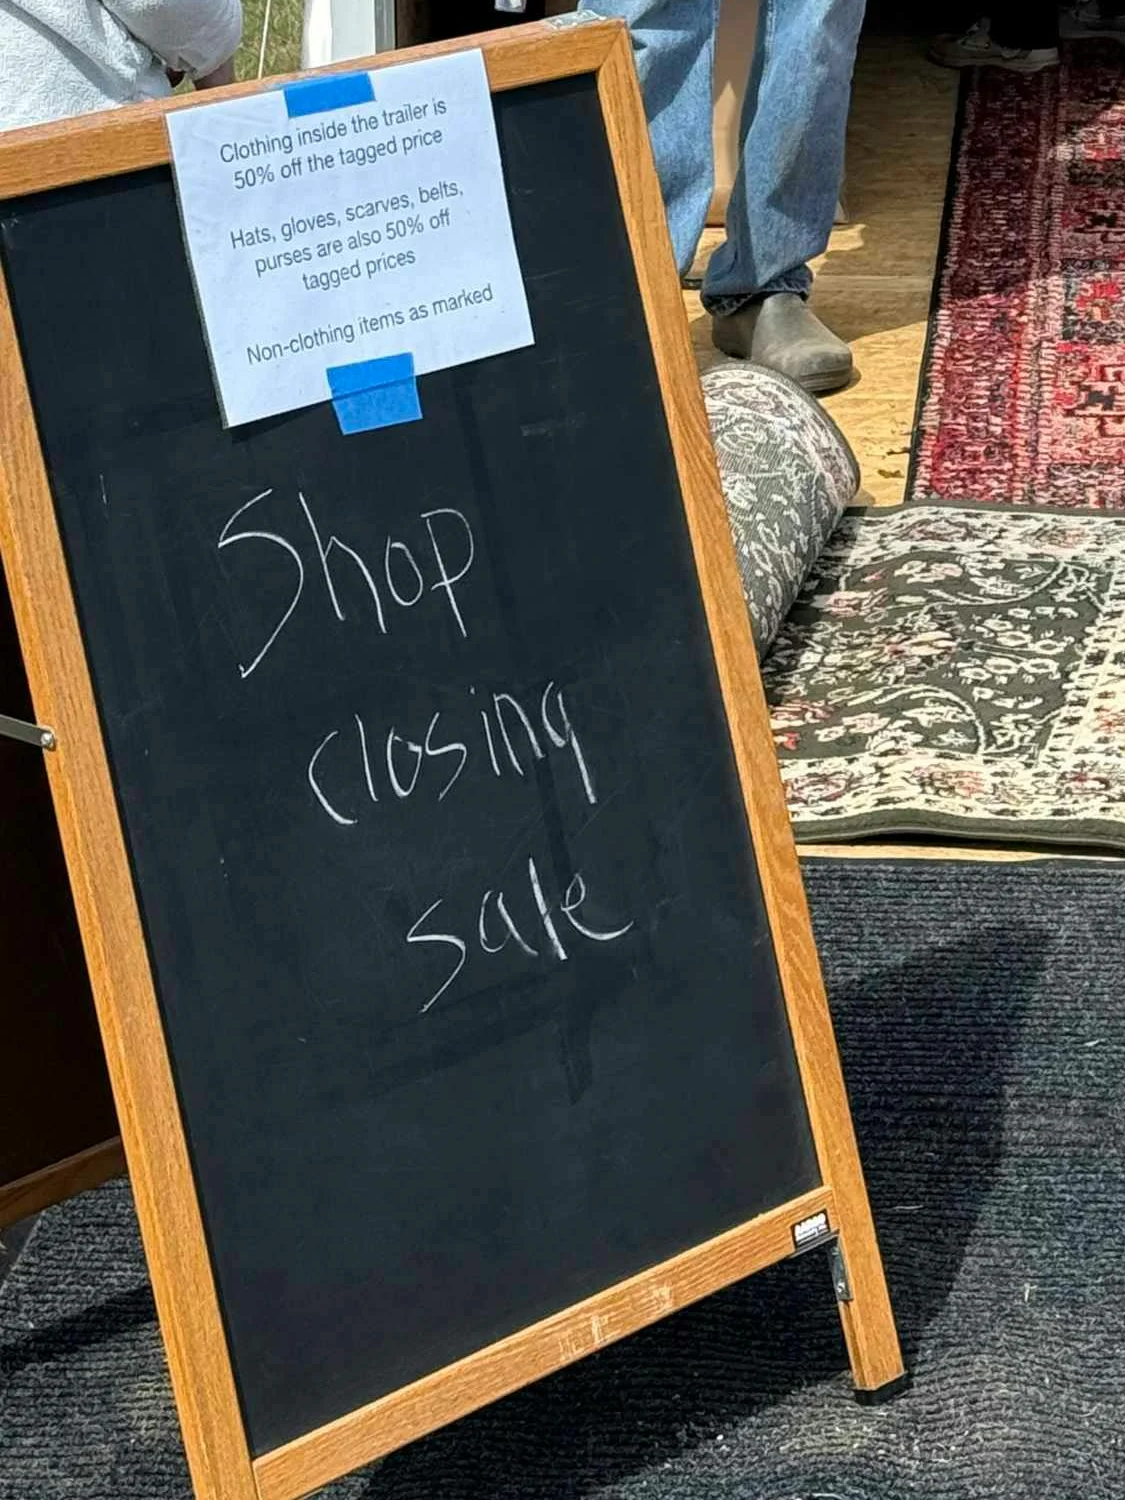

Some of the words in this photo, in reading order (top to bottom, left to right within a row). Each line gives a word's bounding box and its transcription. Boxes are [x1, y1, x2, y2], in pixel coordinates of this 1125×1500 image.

[220, 134, 293, 164] Clothing
[297, 122, 348, 146] inside
[351, 115, 379, 133] the
[382, 105, 428, 127] trailer
[432, 98, 447, 116] is
[234, 165, 275, 190] 50%
[281, 157, 304, 180] off
[307, 154, 334, 173] the
[339, 138, 398, 167] tagged
[402, 130, 443, 156] price
[230, 225, 276, 249] Hats,
[281, 211, 341, 242] gloves,
[346, 194, 415, 221] scarves,
[418, 182, 463, 204] belts,
[254, 243, 312, 278] purses
[317, 239, 343, 259] are
[347, 230, 382, 251] also
[386, 216, 425, 241] 50%
[429, 210, 451, 229] off
[303, 262, 361, 292] tagged
[366, 249, 416, 278] prices
[246, 322, 356, 365] Non-clothing
[358, 309, 405, 336] items
[409, 304, 429, 321] as
[433, 284, 494, 315] marked
[217, 488, 475, 679] Shop
[308, 681, 597, 825] closing
[406, 857, 635, 1013] sale
